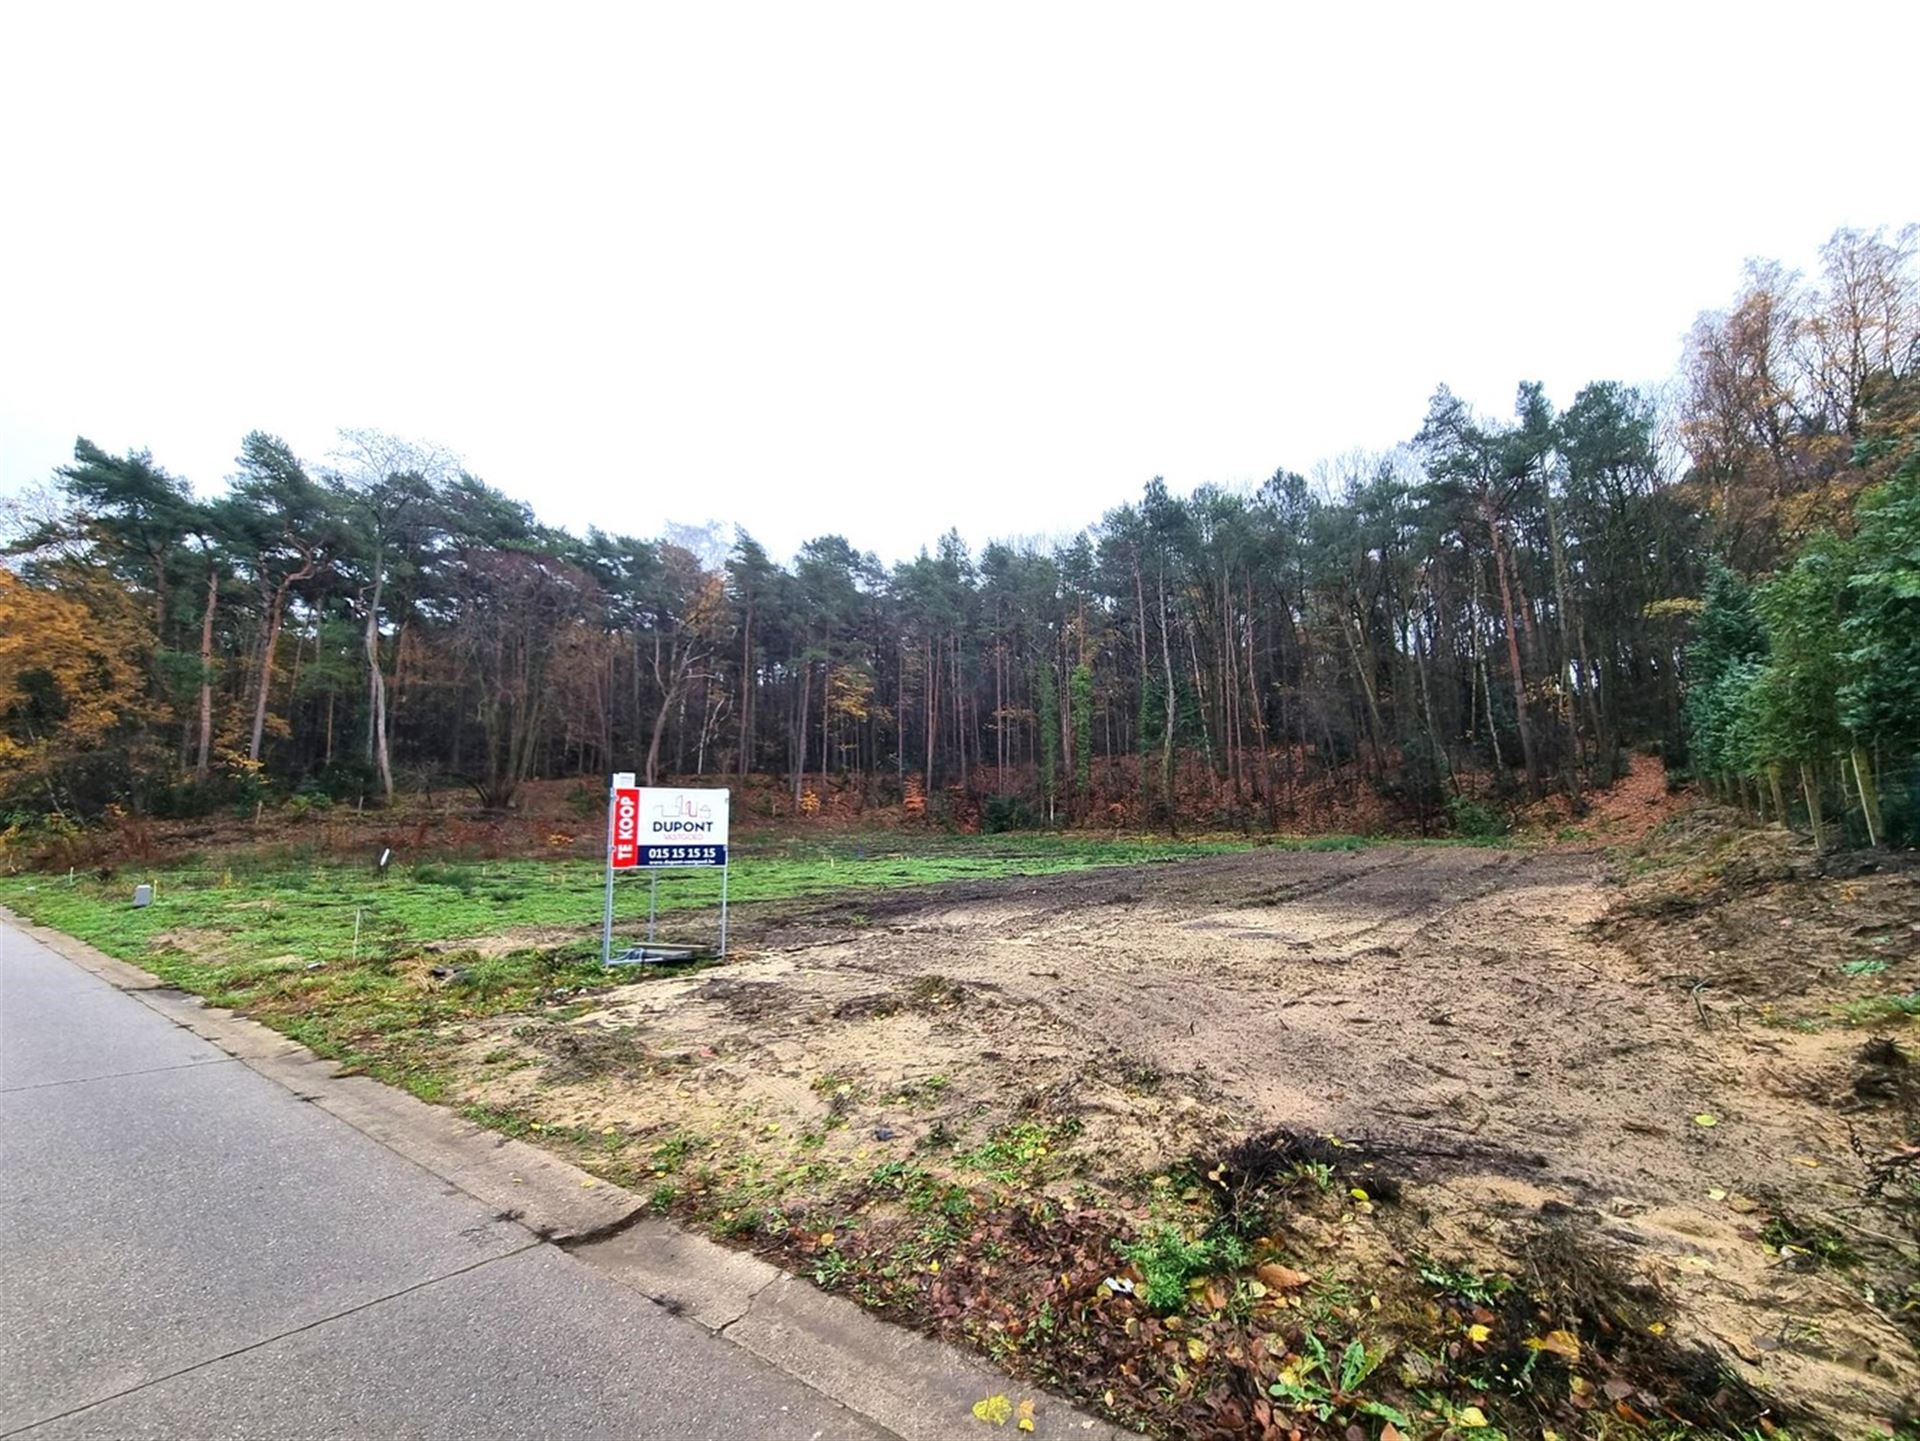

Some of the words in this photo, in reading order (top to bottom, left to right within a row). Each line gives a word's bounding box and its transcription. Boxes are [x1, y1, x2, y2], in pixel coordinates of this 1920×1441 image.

[618, 796, 634, 839] KOOP
[653, 821, 713, 832] DUPONT
[618, 844, 632, 860] TE
[649, 848, 669, 859] 015
[672, 848, 685, 858] 15
[687, 848, 700, 858] 15
[703, 848, 716, 858] 15
